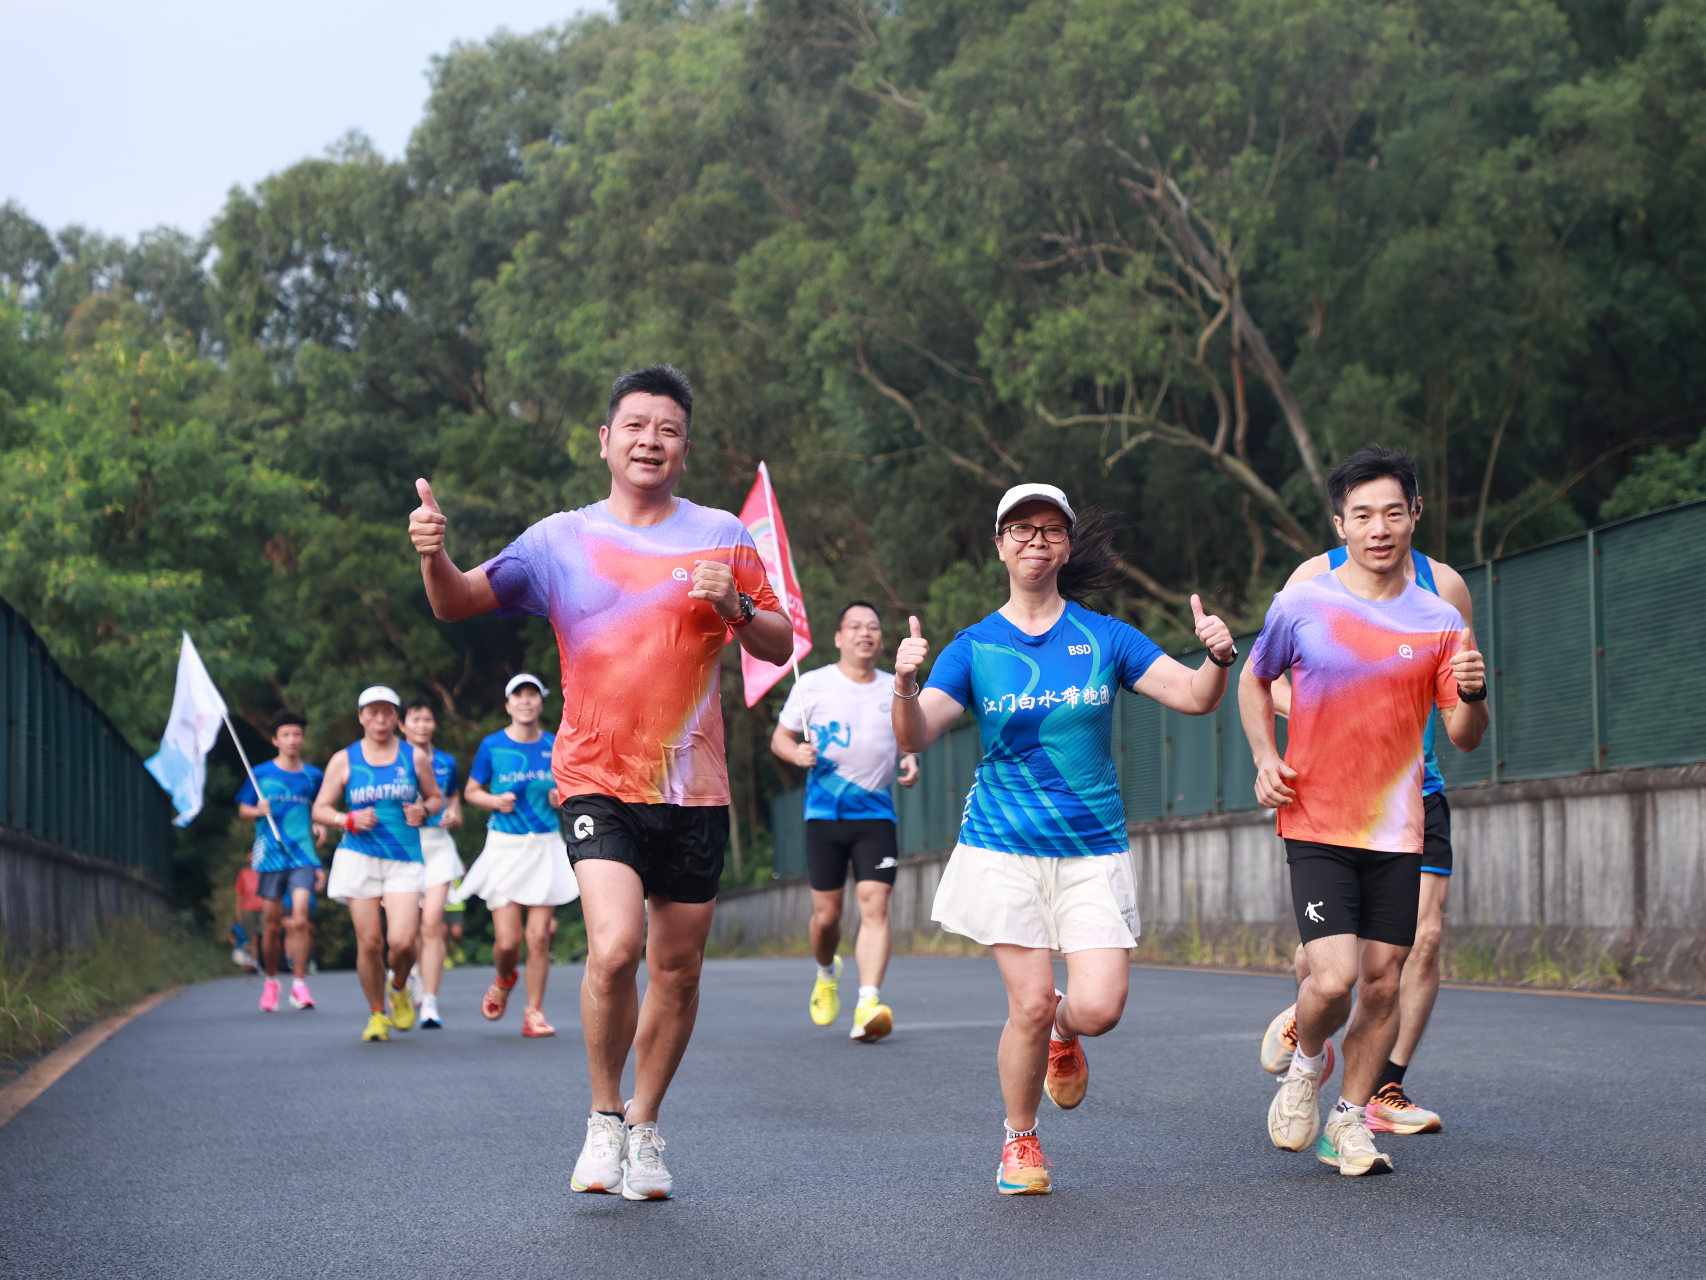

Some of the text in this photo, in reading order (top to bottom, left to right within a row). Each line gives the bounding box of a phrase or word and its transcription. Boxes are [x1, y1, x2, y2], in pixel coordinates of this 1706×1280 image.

[1067, 643, 1092, 656] BSD
[983, 685, 1110, 715] 江门白水带跑团
